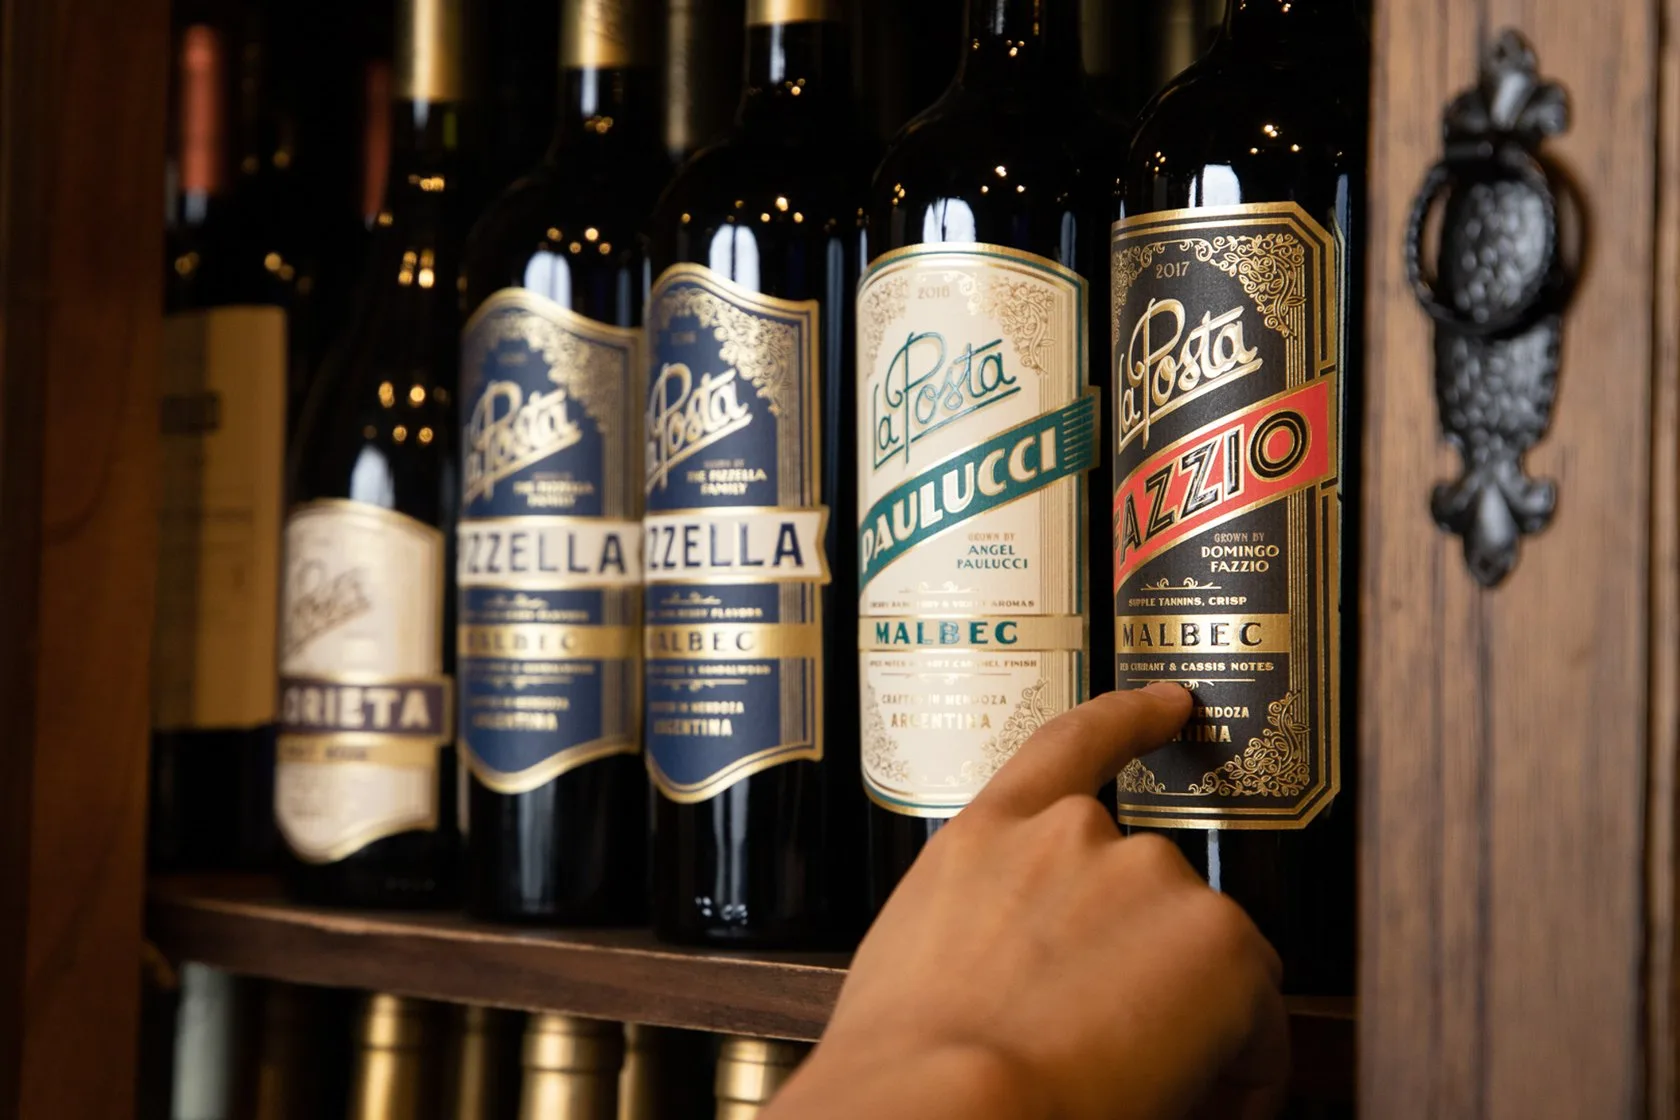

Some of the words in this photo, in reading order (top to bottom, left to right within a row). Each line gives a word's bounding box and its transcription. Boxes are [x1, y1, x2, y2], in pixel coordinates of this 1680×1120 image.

[1155, 261, 1190, 279] 2017
[1127, 298, 1264, 450] Posta
[885, 331, 1022, 464] Posta
[860, 426, 1058, 574] PAULUCCI
[967, 532, 1000, 542] GROWN
[1004, 532, 1016, 542] BY
[1214, 533, 1248, 543] GROWN
[1252, 532, 1265, 542] BY
[967, 544, 1016, 556] ANGEL
[1201, 544, 1280, 559] DOMINGO
[956, 558, 1029, 570] PAULUCCI
[1210, 560, 1270, 573] FAZZIO
[1158, 598, 1205, 607] TANNINS,
[1208, 596, 1248, 606] CRISP
[875, 621, 1019, 645] MALBEC
[1122, 622, 1263, 648] MALBEC
[1169, 662, 1177, 671] &
[1181, 661, 1226, 671] CASSIS
[1231, 660, 1275, 671] NOTES
[945, 693, 1007, 705] MENDOZA
[891, 713, 991, 729] ARGENTINA
